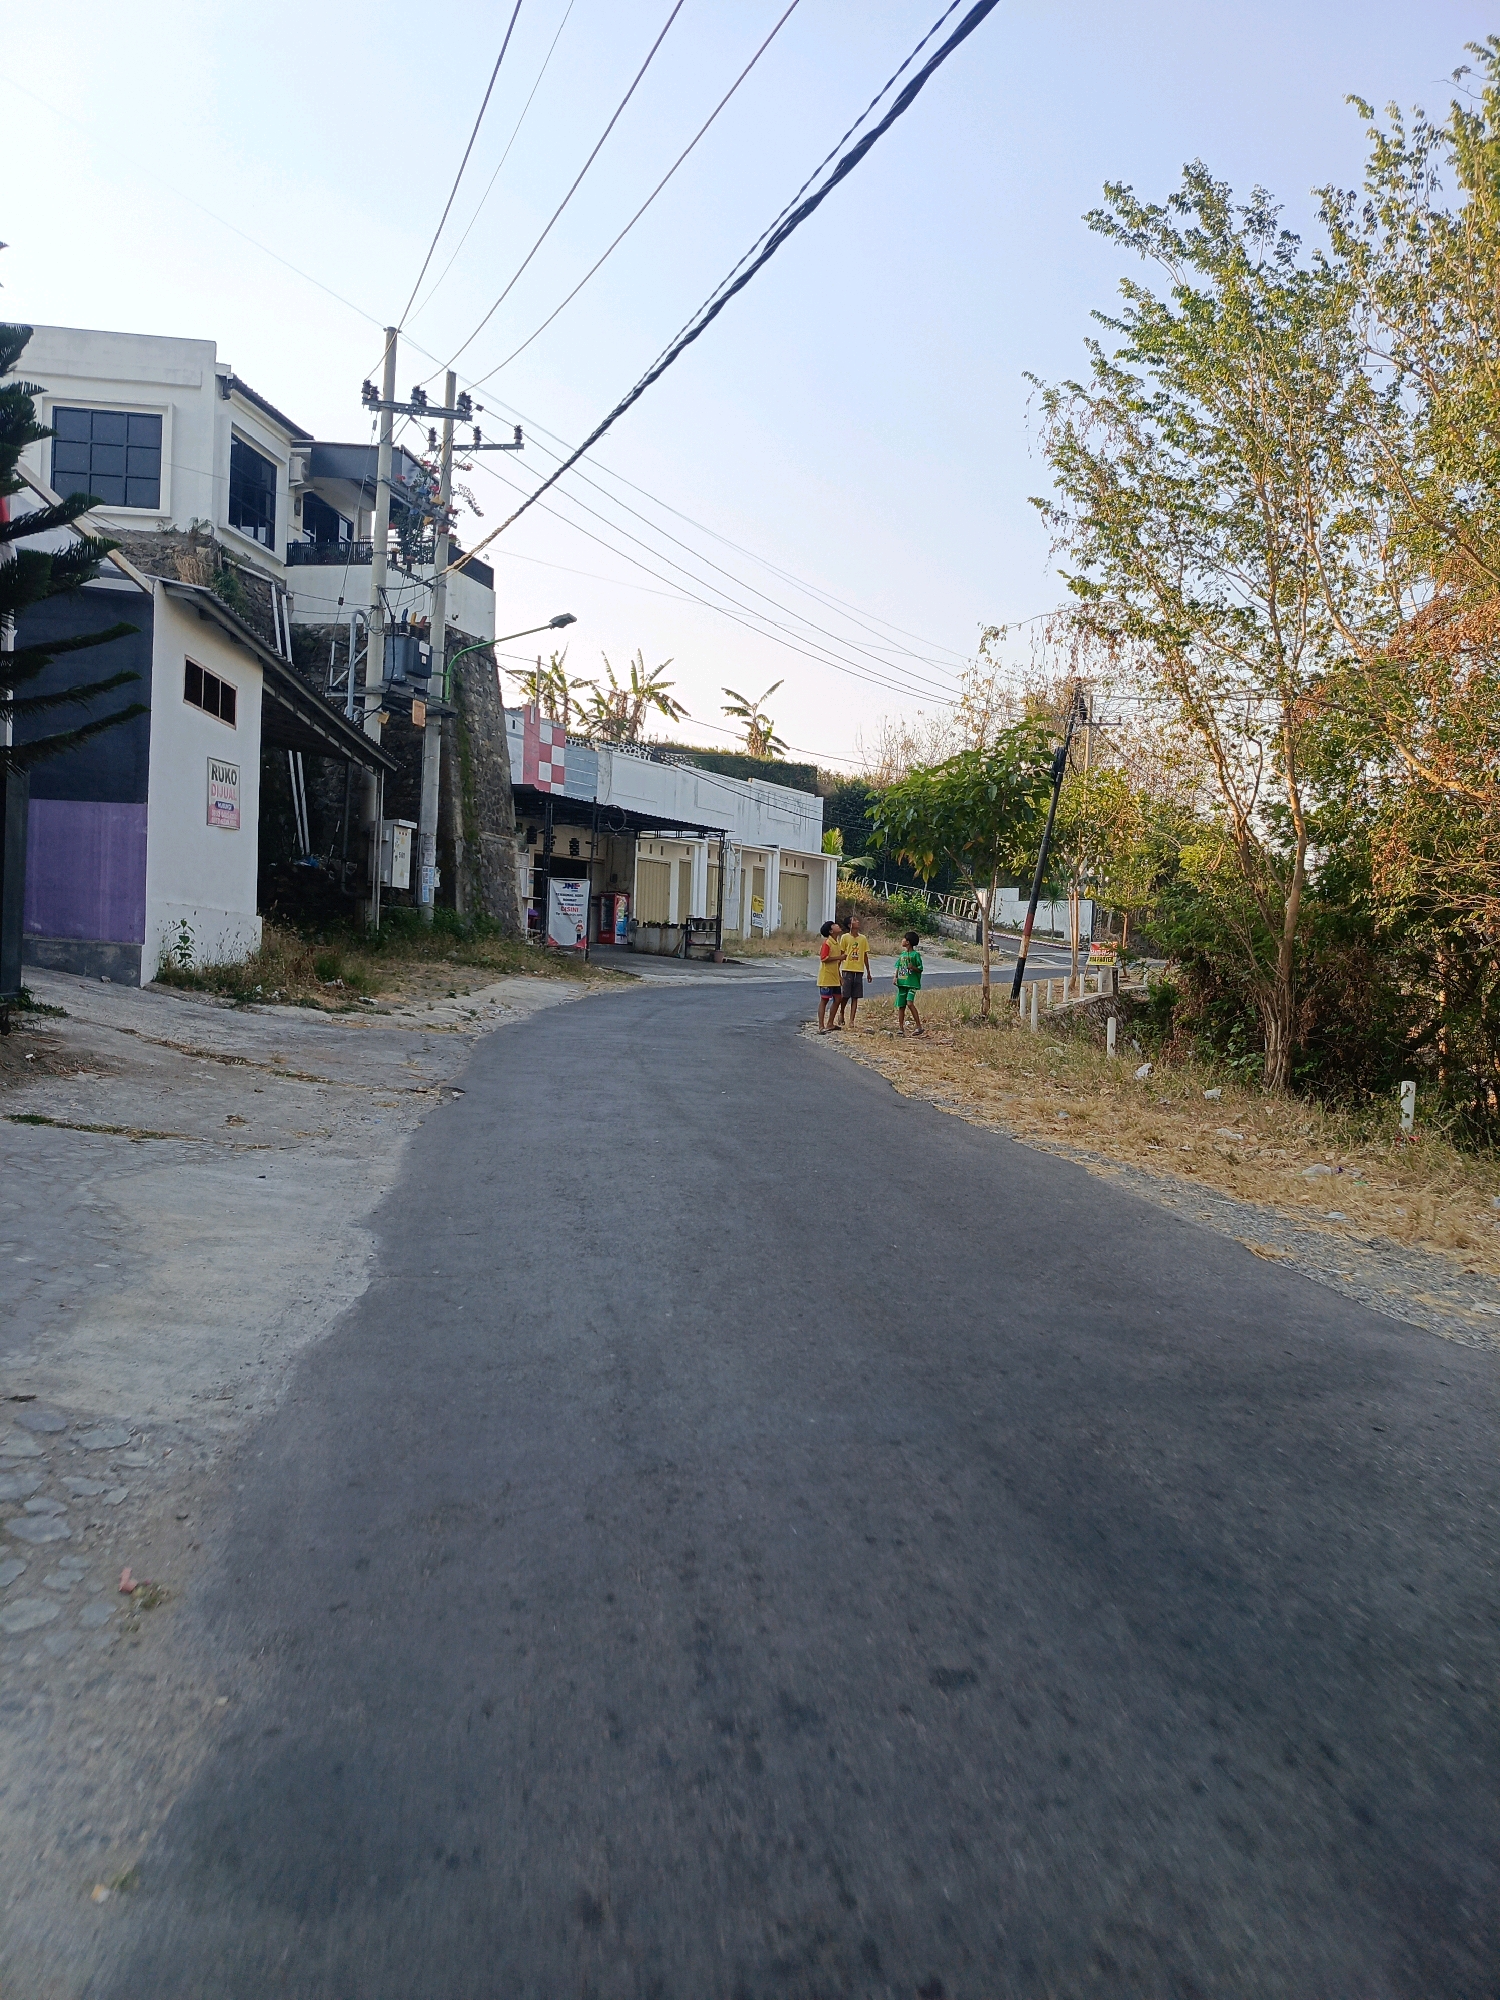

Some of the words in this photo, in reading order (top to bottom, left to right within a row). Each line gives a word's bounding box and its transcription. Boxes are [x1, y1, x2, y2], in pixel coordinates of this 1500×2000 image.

[211, 763, 237, 785] RUKO
[211, 783, 237, 801] DIJUAL
[562, 882, 581, 890] JNE
